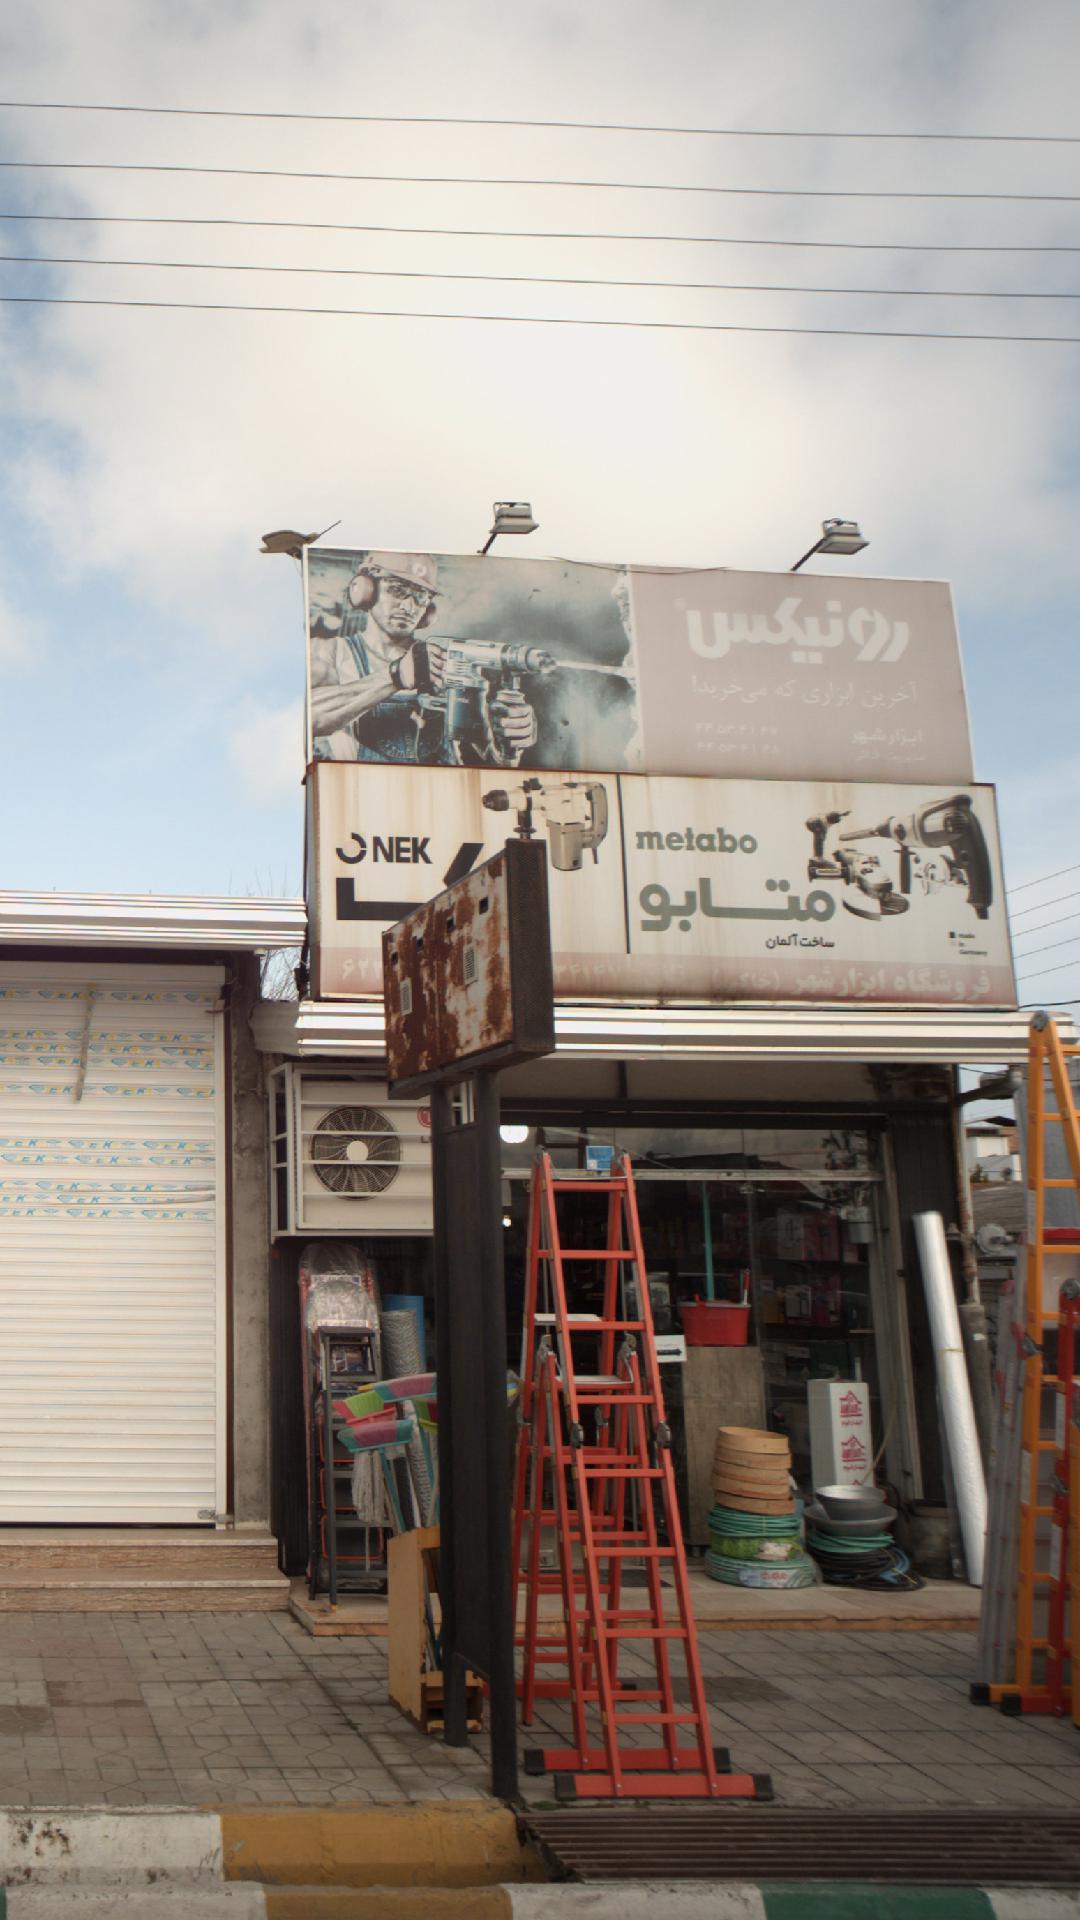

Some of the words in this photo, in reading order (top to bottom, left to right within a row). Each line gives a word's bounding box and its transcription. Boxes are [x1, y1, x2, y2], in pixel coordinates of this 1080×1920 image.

[686, 597, 910, 664] رونیکس
[775, 679, 797, 697] که
[801, 681, 855, 707] ابزاری
[861, 680, 920, 709] آخرین
[635, 827, 759, 854] metabo
[639, 877, 836, 932] متابو
[764, 932, 799, 950] آلمان
[799, 936, 836, 948] ساخت
[893, 967, 991, 1001] فروشگاه
